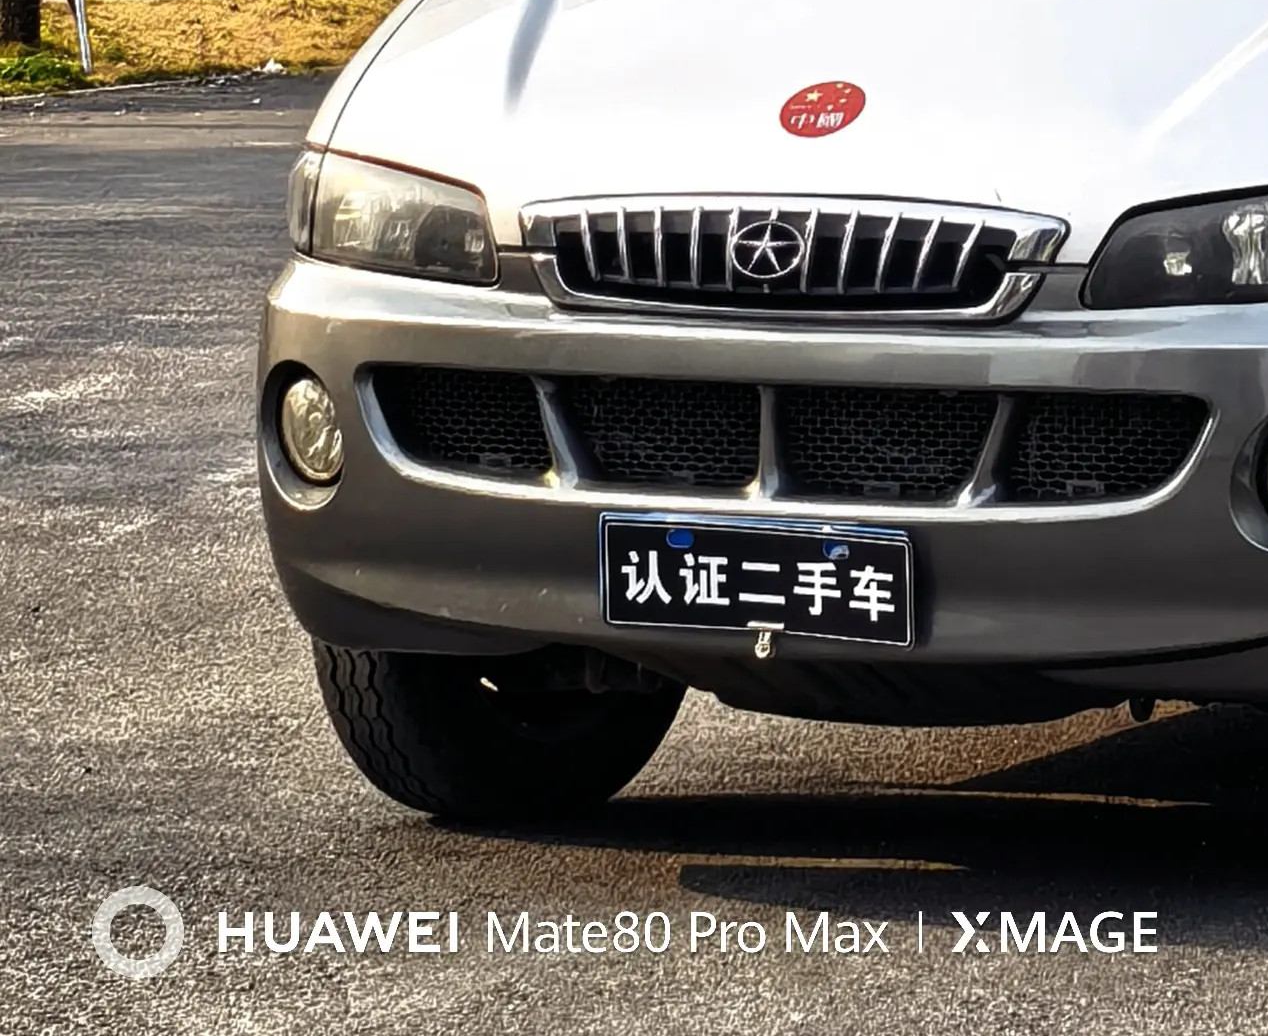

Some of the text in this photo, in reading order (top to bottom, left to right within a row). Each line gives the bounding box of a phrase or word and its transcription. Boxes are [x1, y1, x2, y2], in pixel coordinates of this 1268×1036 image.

[620, 549, 895, 623] 认证二手车
